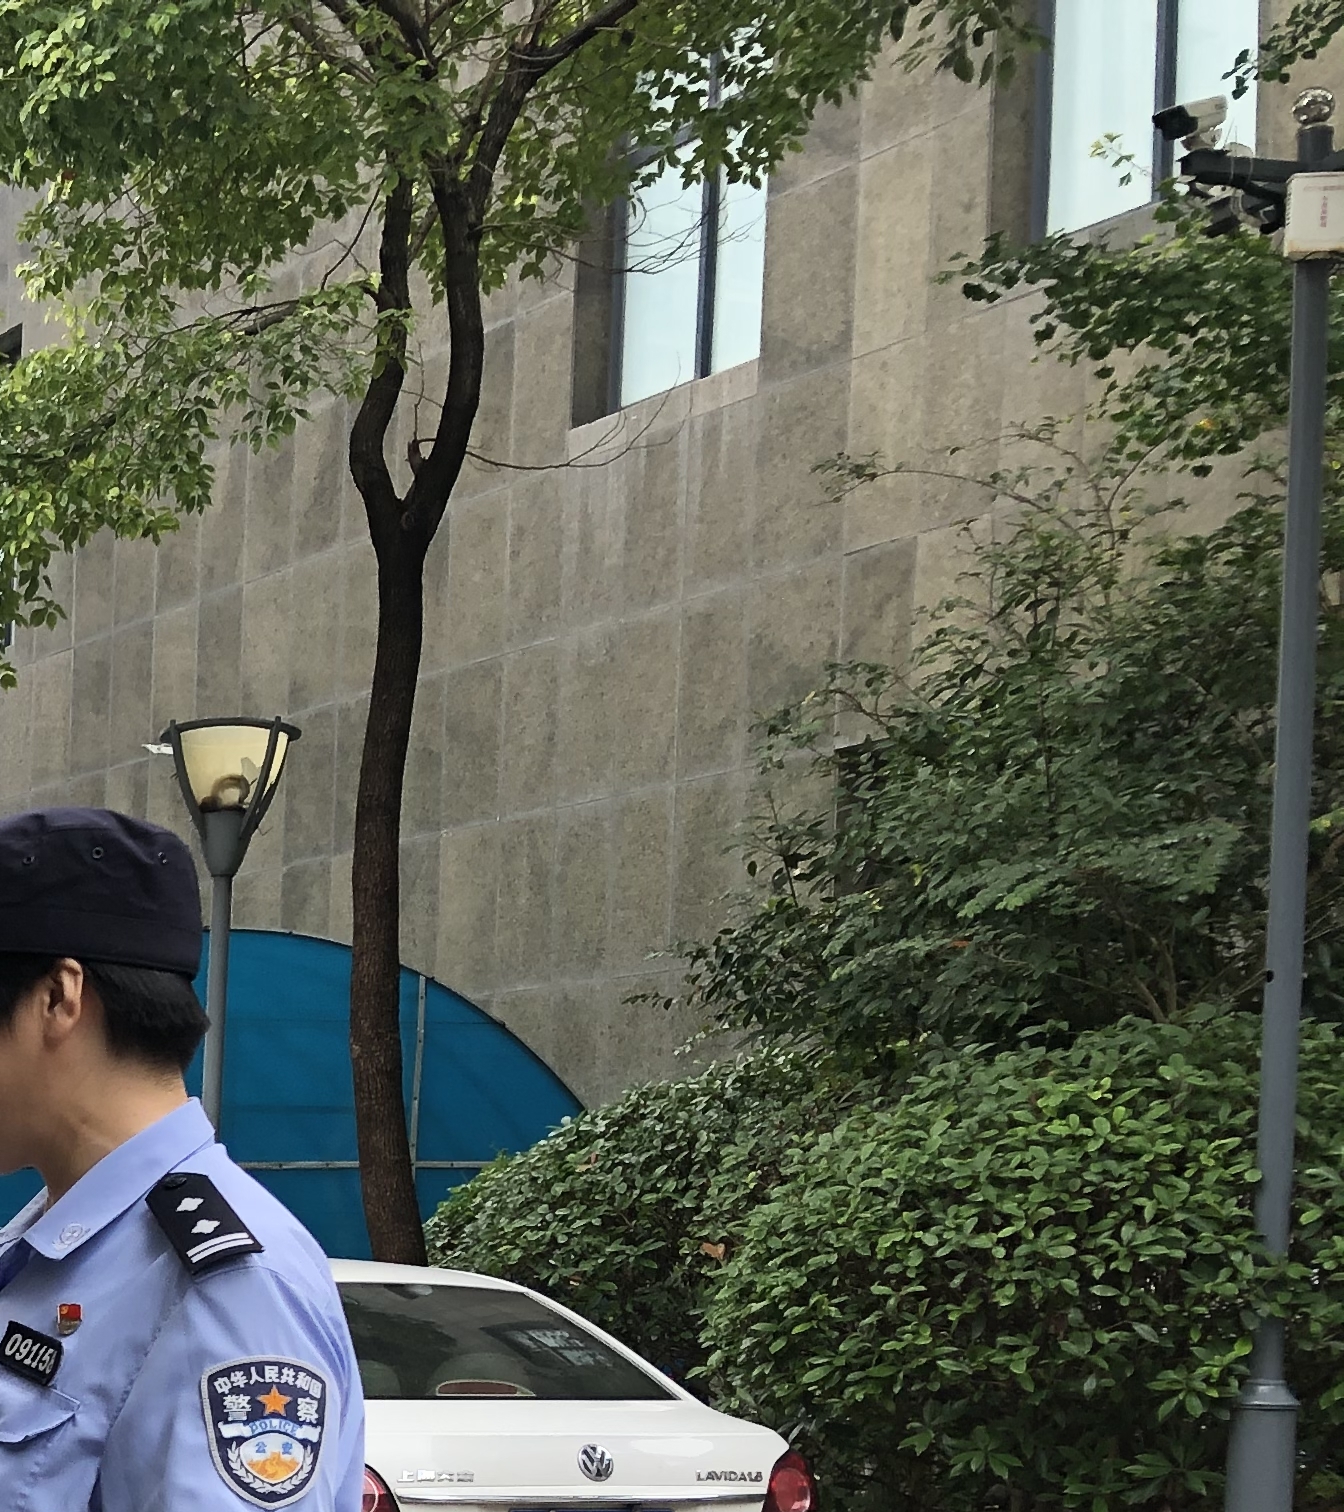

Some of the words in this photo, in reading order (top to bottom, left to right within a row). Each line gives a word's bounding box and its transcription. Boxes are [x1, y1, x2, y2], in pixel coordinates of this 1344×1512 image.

[214, 1365, 323, 1399] 中华人民共和国
[248, 1418, 300, 1437] POLICE
